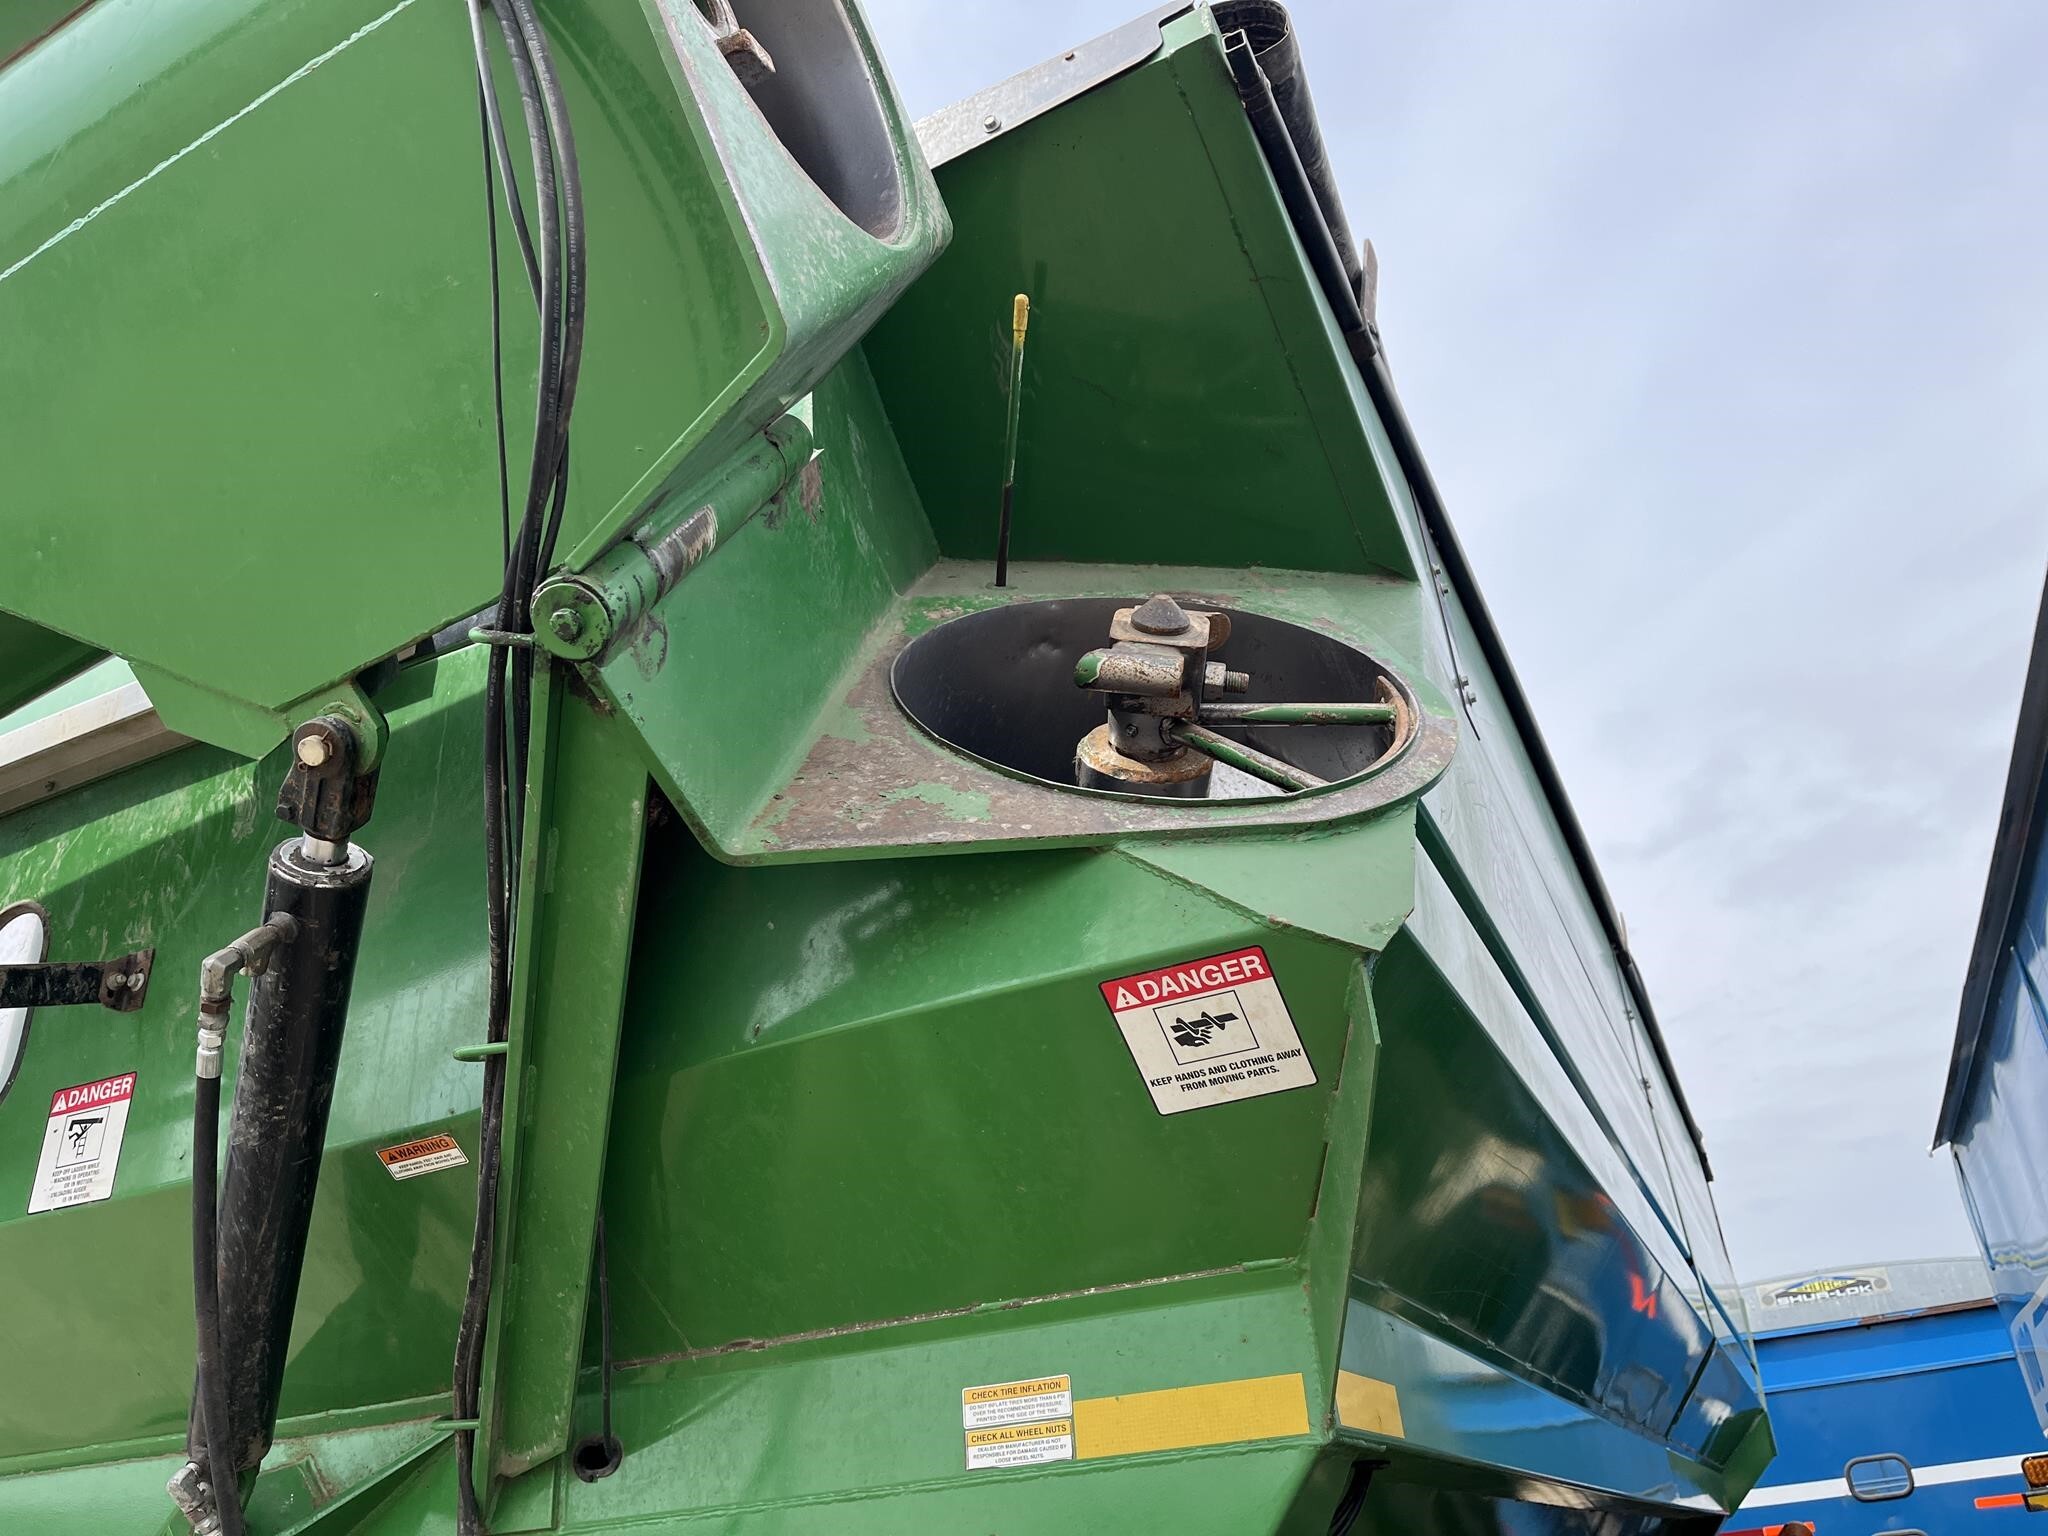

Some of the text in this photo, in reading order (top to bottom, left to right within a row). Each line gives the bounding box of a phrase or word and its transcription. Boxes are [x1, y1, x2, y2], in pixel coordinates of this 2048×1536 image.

[1136, 954, 1266, 1001] DANGER
[1150, 1048, 1302, 1088] KEEP HANDS AND CLOTHING AWAY
[1180, 1065, 1280, 1092] FROM MOVING PARTS.
[68, 1076, 133, 1107] DANGER
[394, 1138, 450, 1159] WARNING
[971, 1381, 1061, 1400] CHECK TIRE INFLATION
[997, 1405, 1035, 1414] RECOMMENDED
[1036, 1400, 1062, 1409] PRESSURE
[971, 1424, 1067, 1443] CHECK ALL WHEEL NUTS
[1005, 1439, 1045, 1449] MANUFACTURER
[973, 1451, 1005, 1459] RESPONSIBLE
